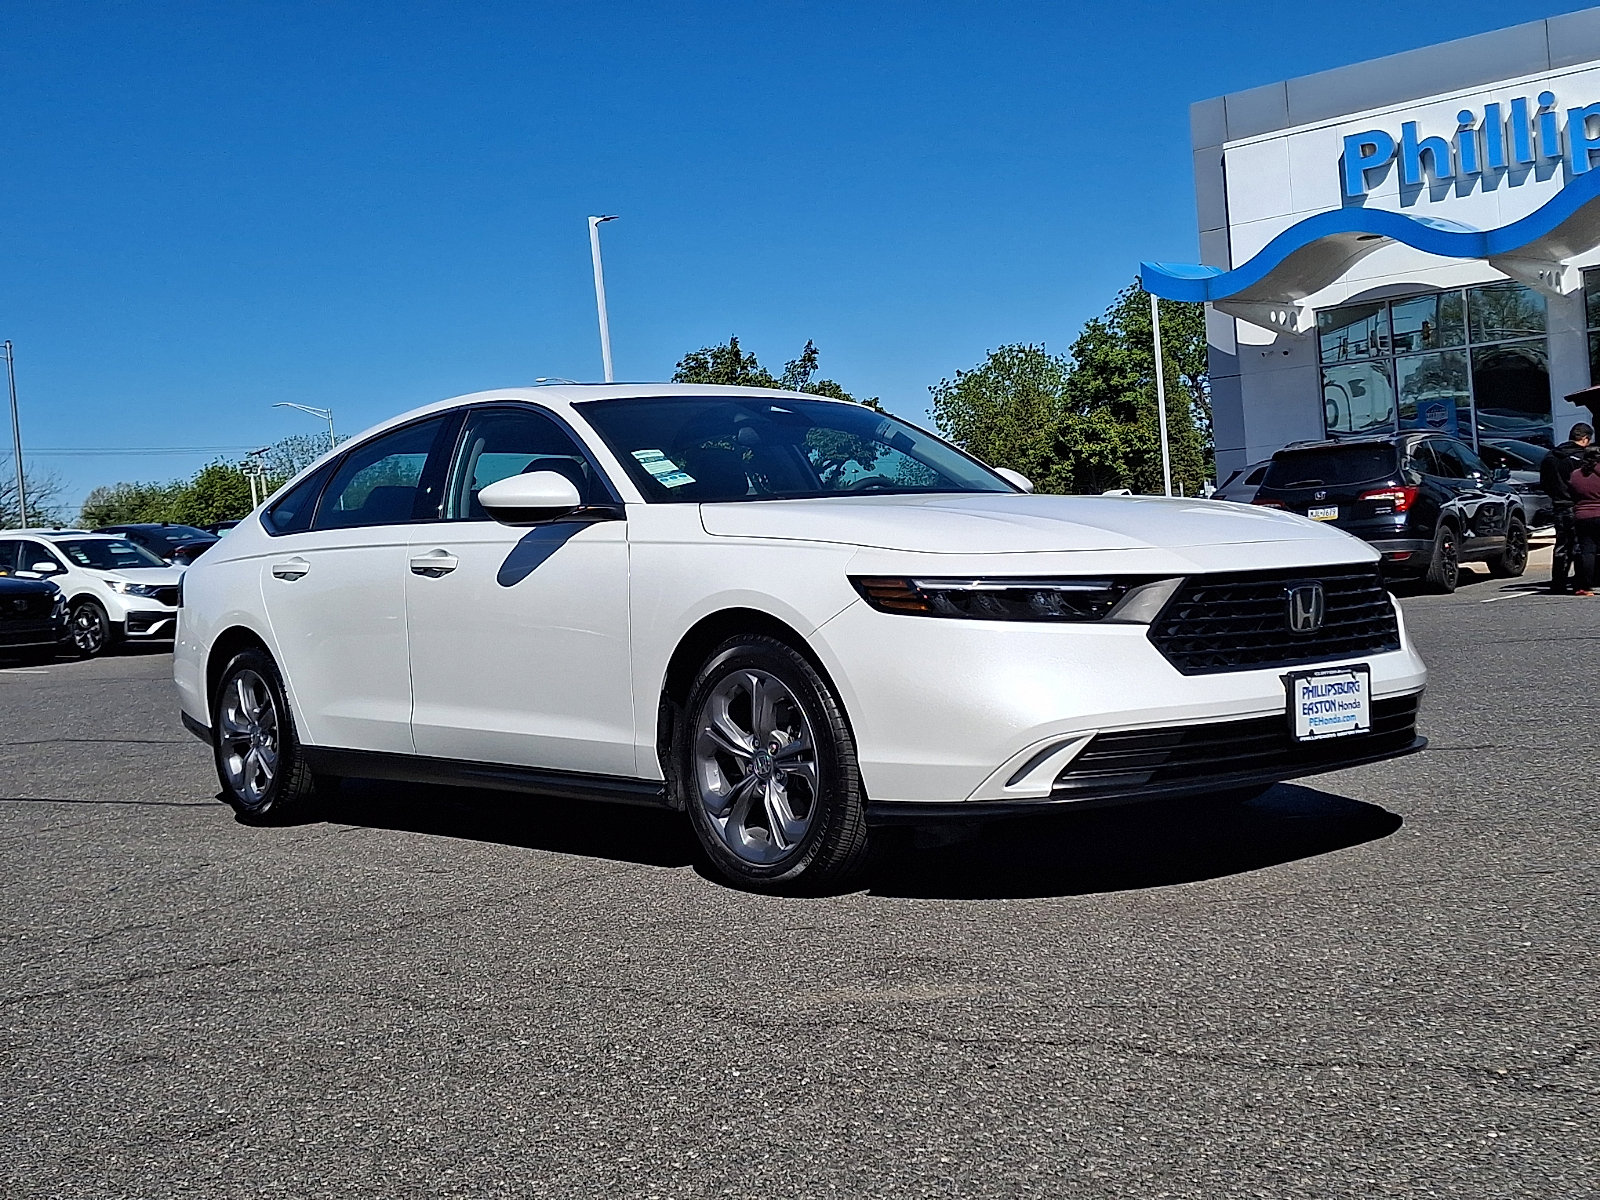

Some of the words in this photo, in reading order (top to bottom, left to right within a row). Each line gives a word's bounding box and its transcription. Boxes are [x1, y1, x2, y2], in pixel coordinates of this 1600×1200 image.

[1343, 90, 1600, 197] Phillip
[1302, 681, 1360, 700] PHILLIPSBURG
[1302, 699, 1337, 716] EASTON
[1338, 699, 1361, 711] Honda
[1309, 714, 1357, 727] PEHonda.com
